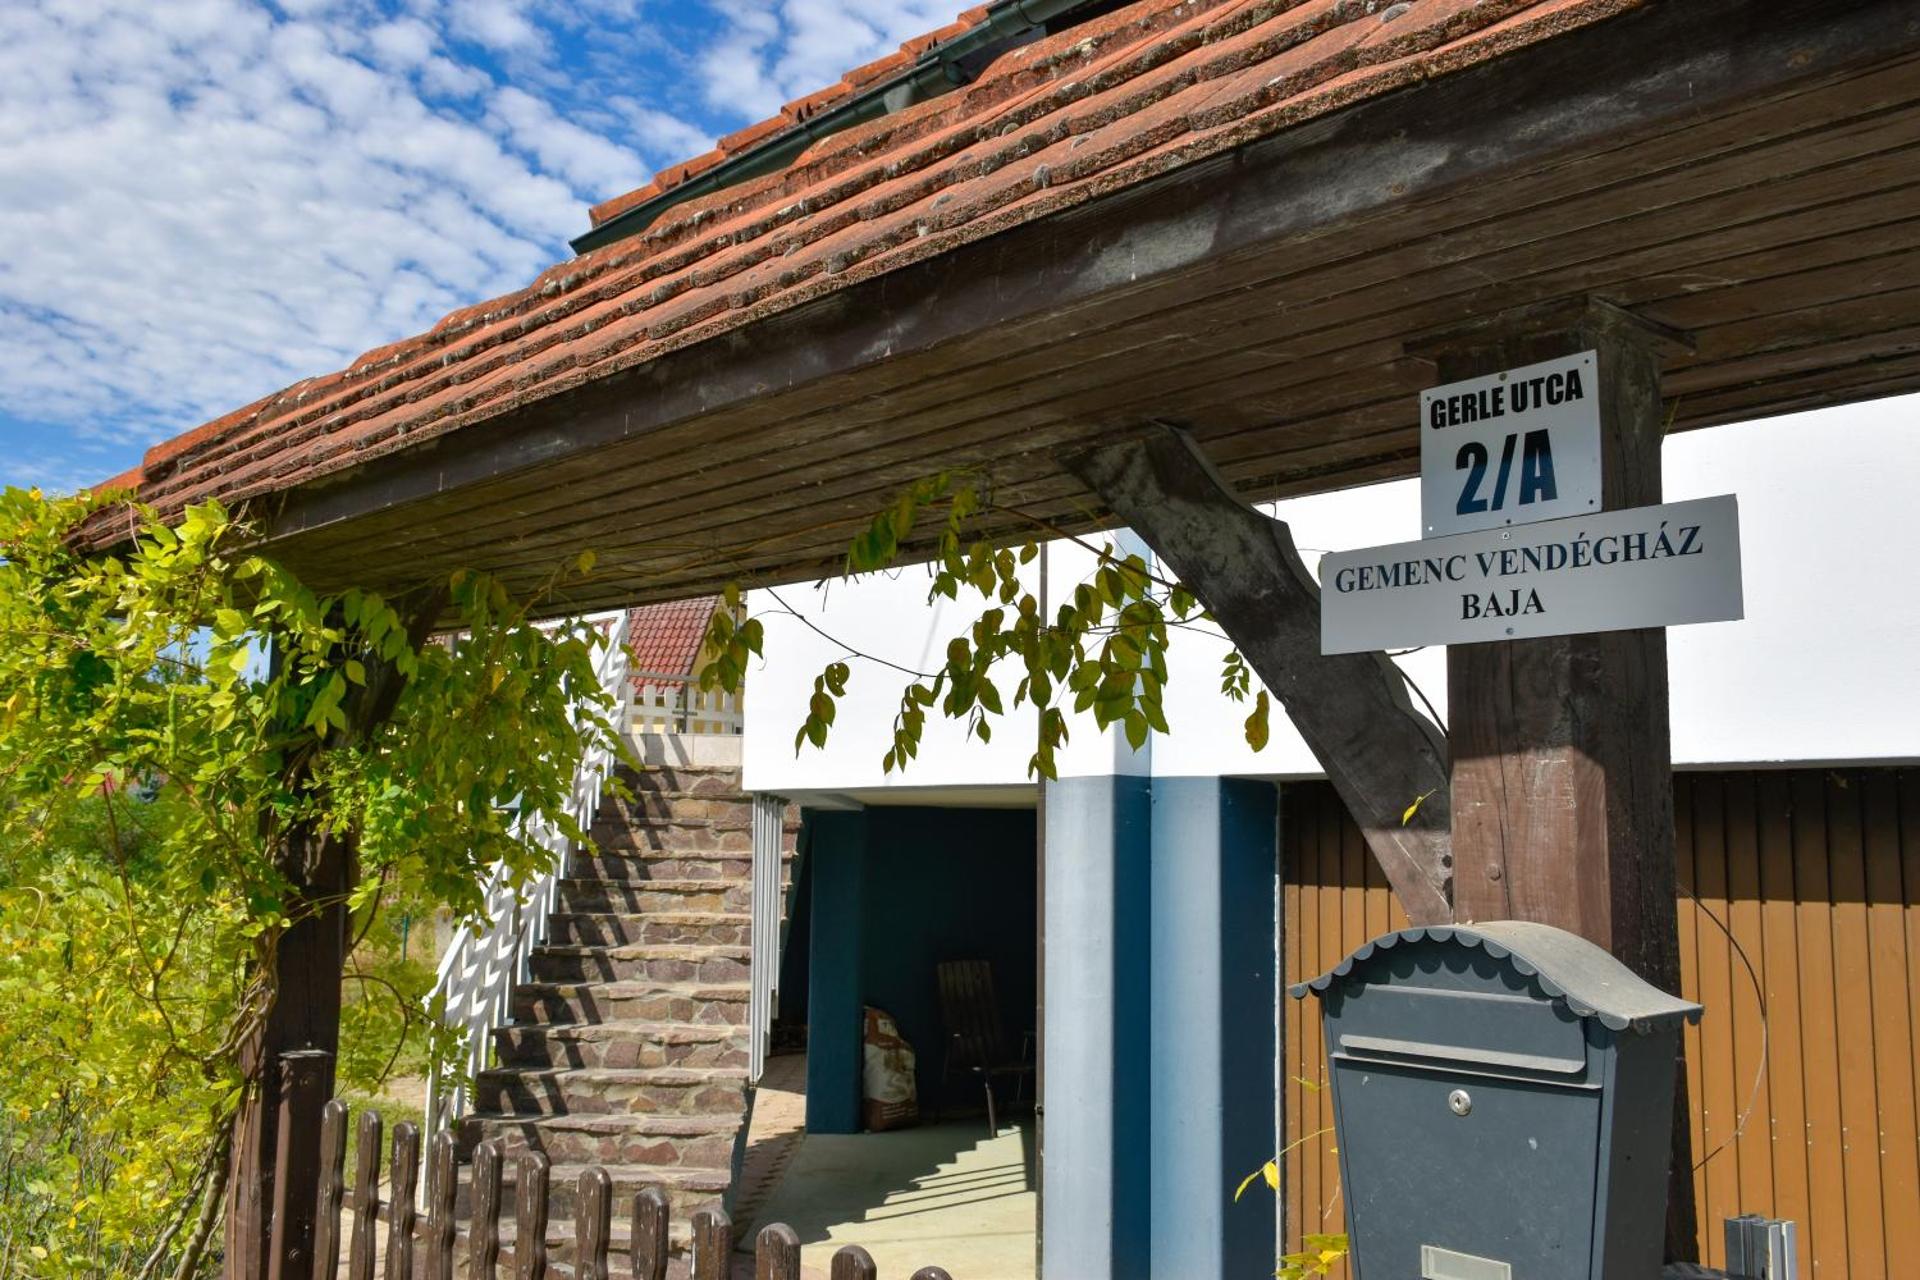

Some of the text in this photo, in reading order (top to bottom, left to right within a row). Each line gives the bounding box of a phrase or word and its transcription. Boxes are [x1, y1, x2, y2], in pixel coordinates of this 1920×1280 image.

[1430, 368, 1584, 430] GERLE UTCA
[1455, 428, 1558, 516] 2/A
[1335, 520, 1704, 594] GEMENC VENDÉGHÁZ
[1461, 587, 1546, 620] BAJA
